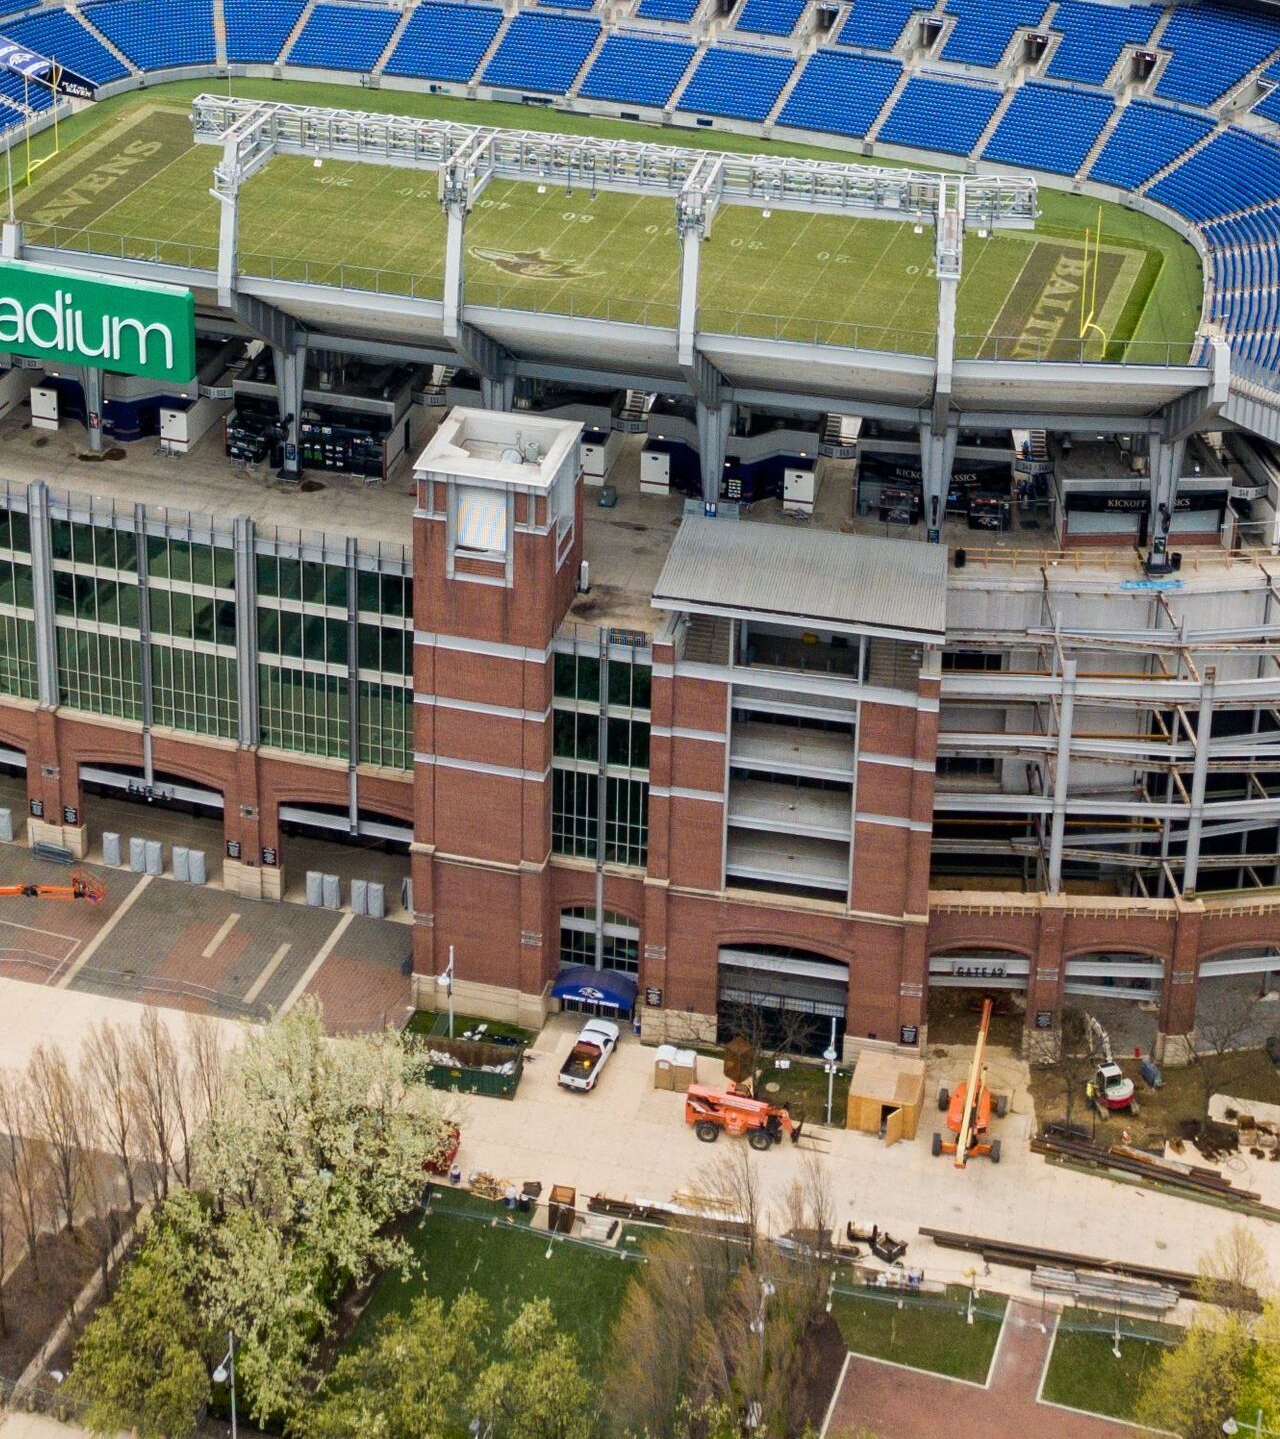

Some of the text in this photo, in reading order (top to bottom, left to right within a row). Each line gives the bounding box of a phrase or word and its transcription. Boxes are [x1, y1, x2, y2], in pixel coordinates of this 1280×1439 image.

[895, 466, 977, 482] KICKO ASSICS
[1106, 497, 1191, 508] KICKOFF SICS
[956, 966, 1004, 978] GATE A2
